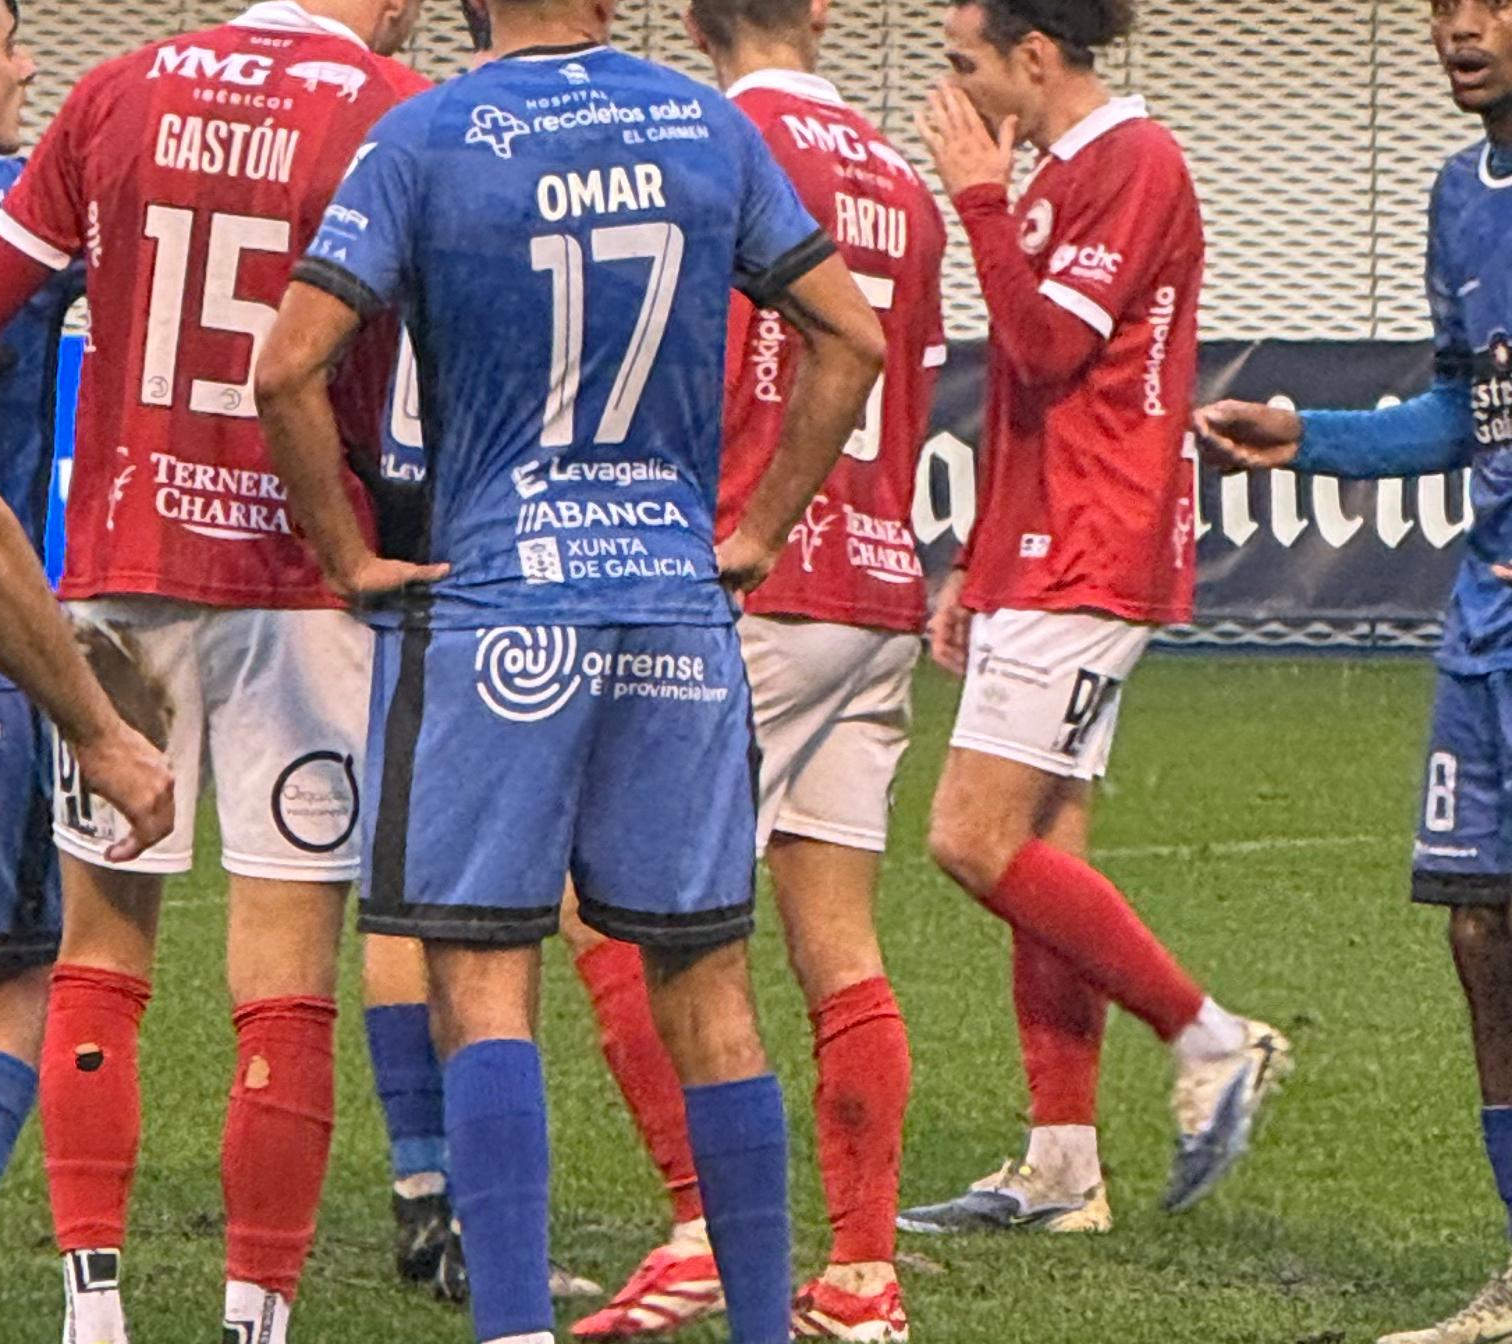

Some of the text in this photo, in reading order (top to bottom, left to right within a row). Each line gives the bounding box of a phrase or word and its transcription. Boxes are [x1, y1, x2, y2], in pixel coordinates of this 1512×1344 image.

[145, 44, 274, 86] MMG
[526, 89, 609, 109] HOSPITAL
[533, 99, 703, 132] recoletos salud
[154, 113, 300, 184] GASTÓN
[623, 129, 645, 144] EL
[537, 163, 666, 222] OMAR
[142, 202, 291, 419] 15
[529, 221, 685, 448] 17
[549, 456, 678, 487] Levagalla
[155, 486, 291, 535] CHARRA
[567, 538, 649, 557] XUNTA
[569, 558, 698, 580] DE GALICIA
